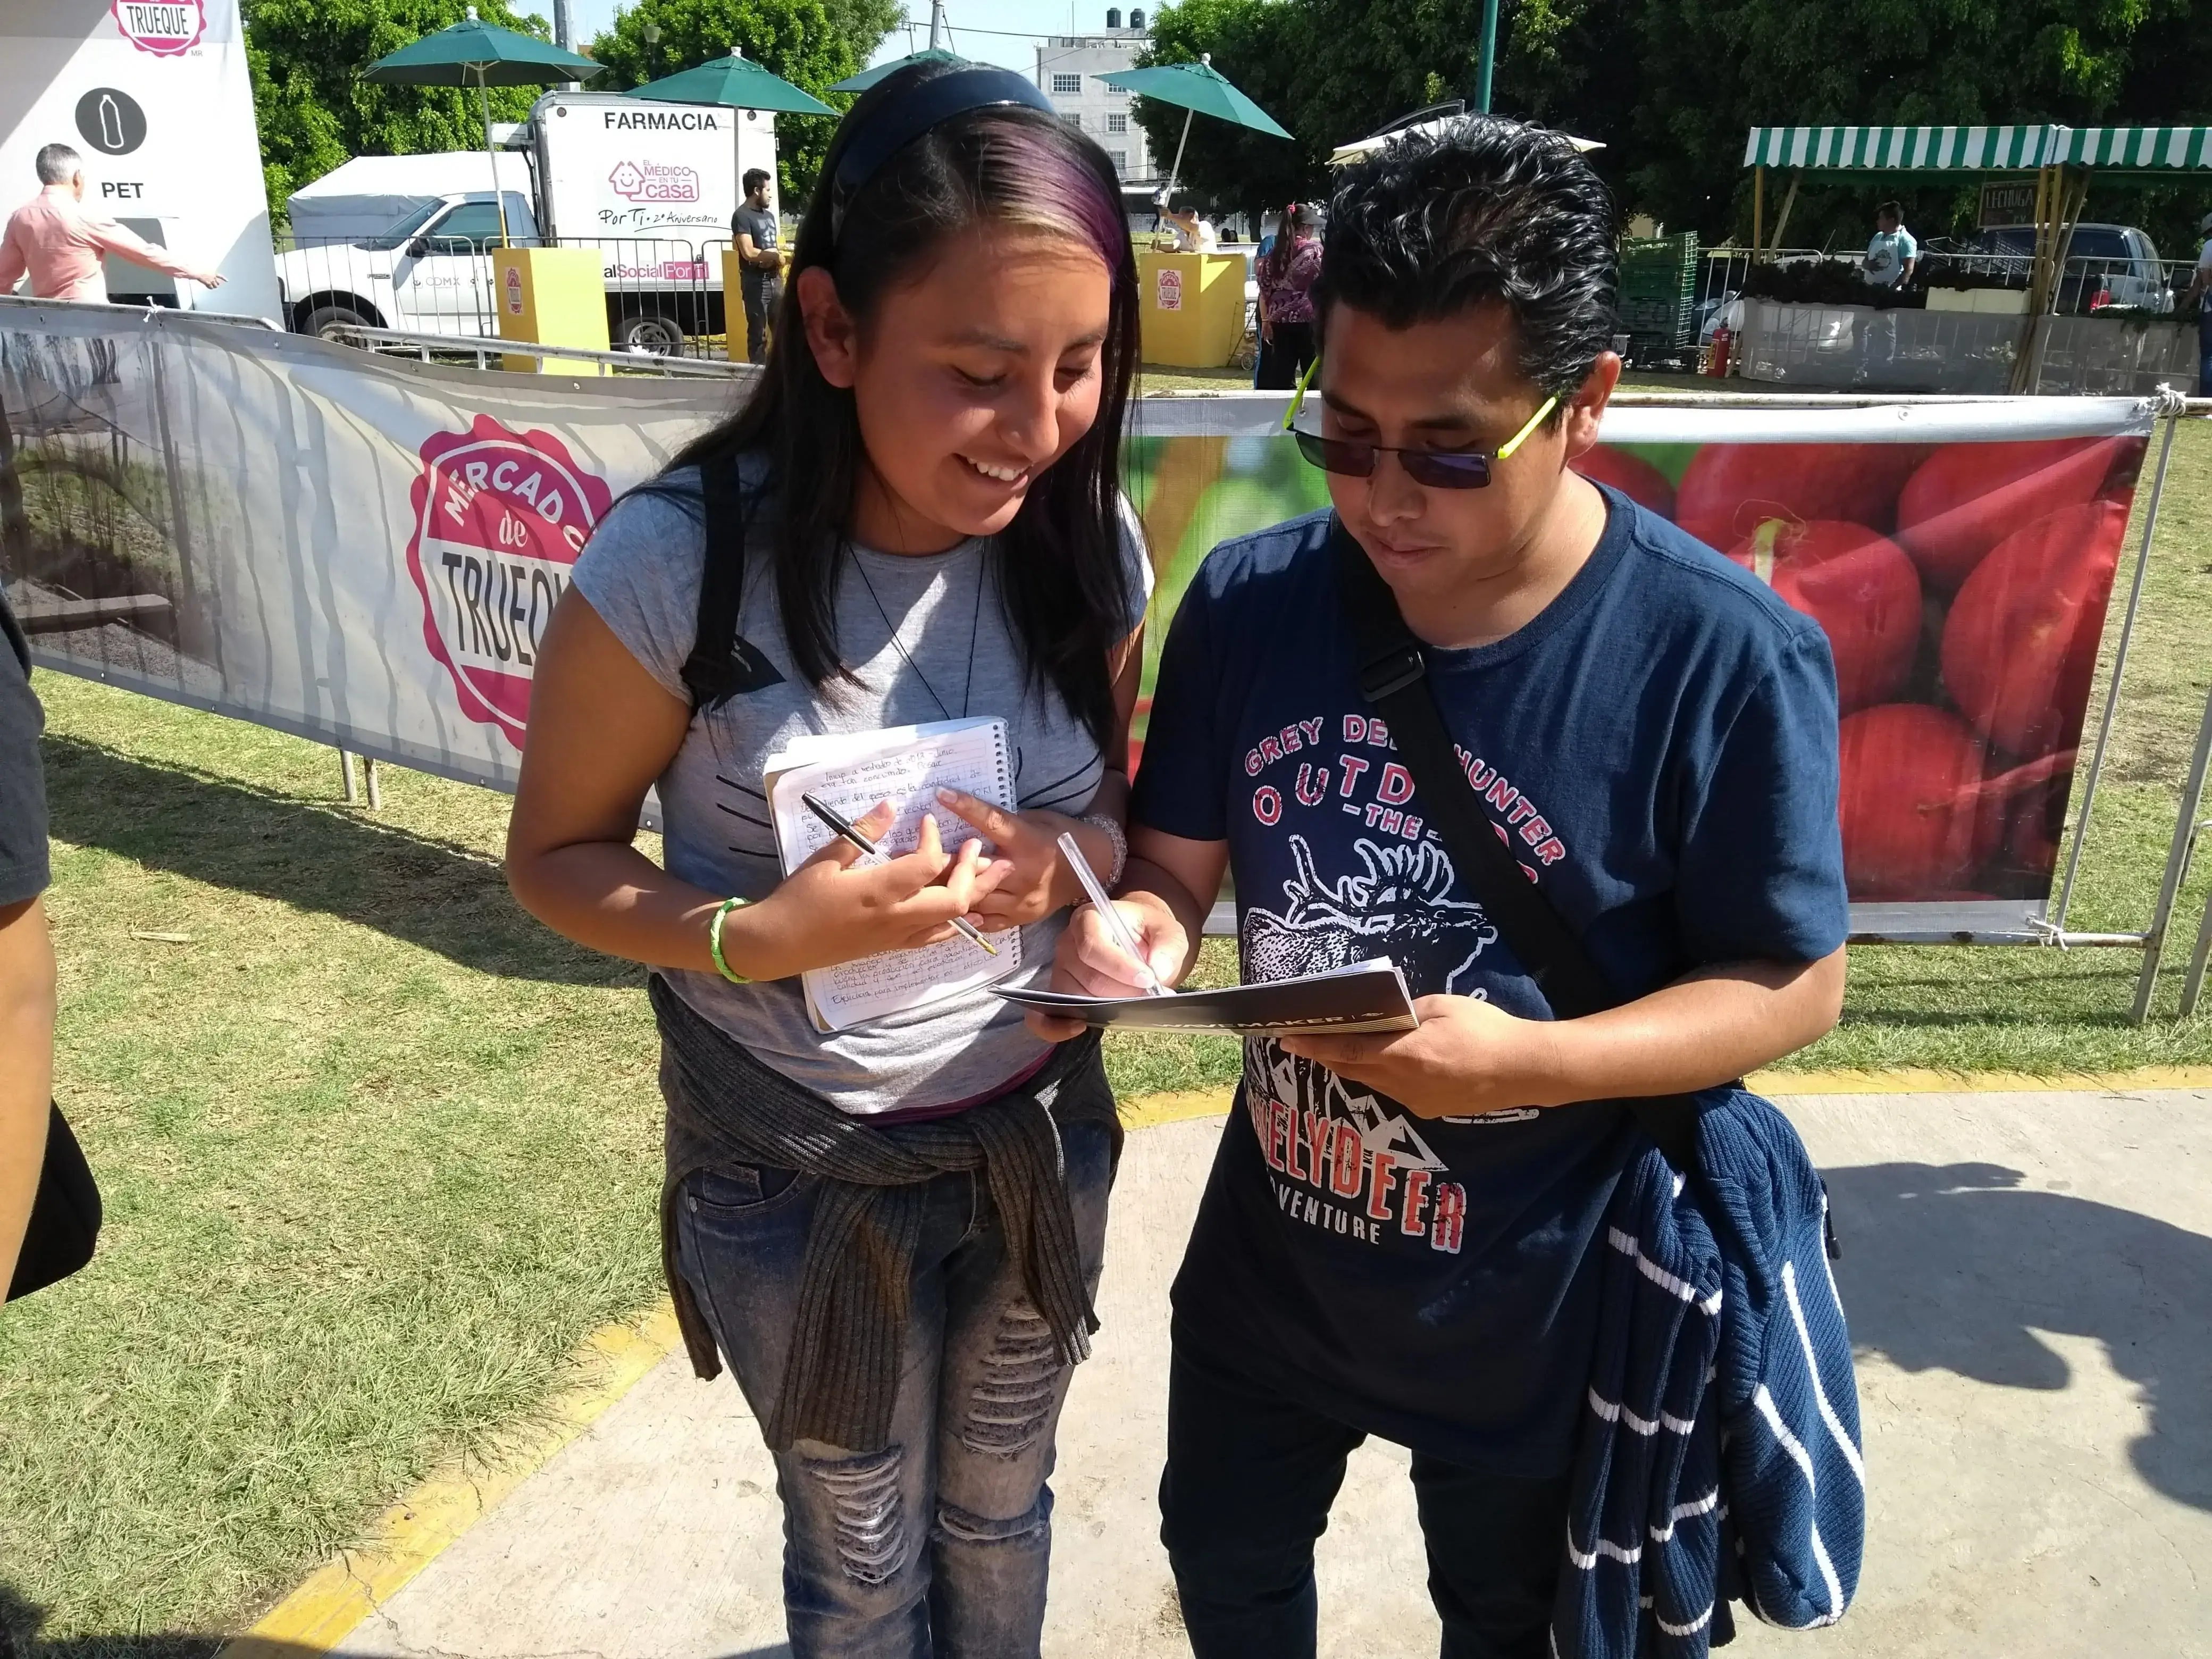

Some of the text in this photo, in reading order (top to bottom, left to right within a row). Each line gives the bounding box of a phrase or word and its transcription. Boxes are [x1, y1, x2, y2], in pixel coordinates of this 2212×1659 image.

[127, 5, 189, 35] TRUEQUE
[605, 112, 717, 130] FARMACIA
[644, 163, 691, 177] MÉDICO
[101, 181, 144, 199] PET
[646, 184, 694, 198] casa
[598, 209, 627, 225] Por
[666, 211, 718, 223] Aniversario
[426, 276, 460, 286] CDMX
[445, 460, 588, 552] MERCADO
[499, 509, 528, 548] de
[442, 551, 572, 666] TRUEQ
[1245, 716, 1323, 776] GREY
[1343, 714, 1398, 751] DE
[852, 792, 864, 802] del
[1152, 1016, 1345, 1028] WAVEMAKER
[1270, 1174, 1380, 1245] VENTURE
